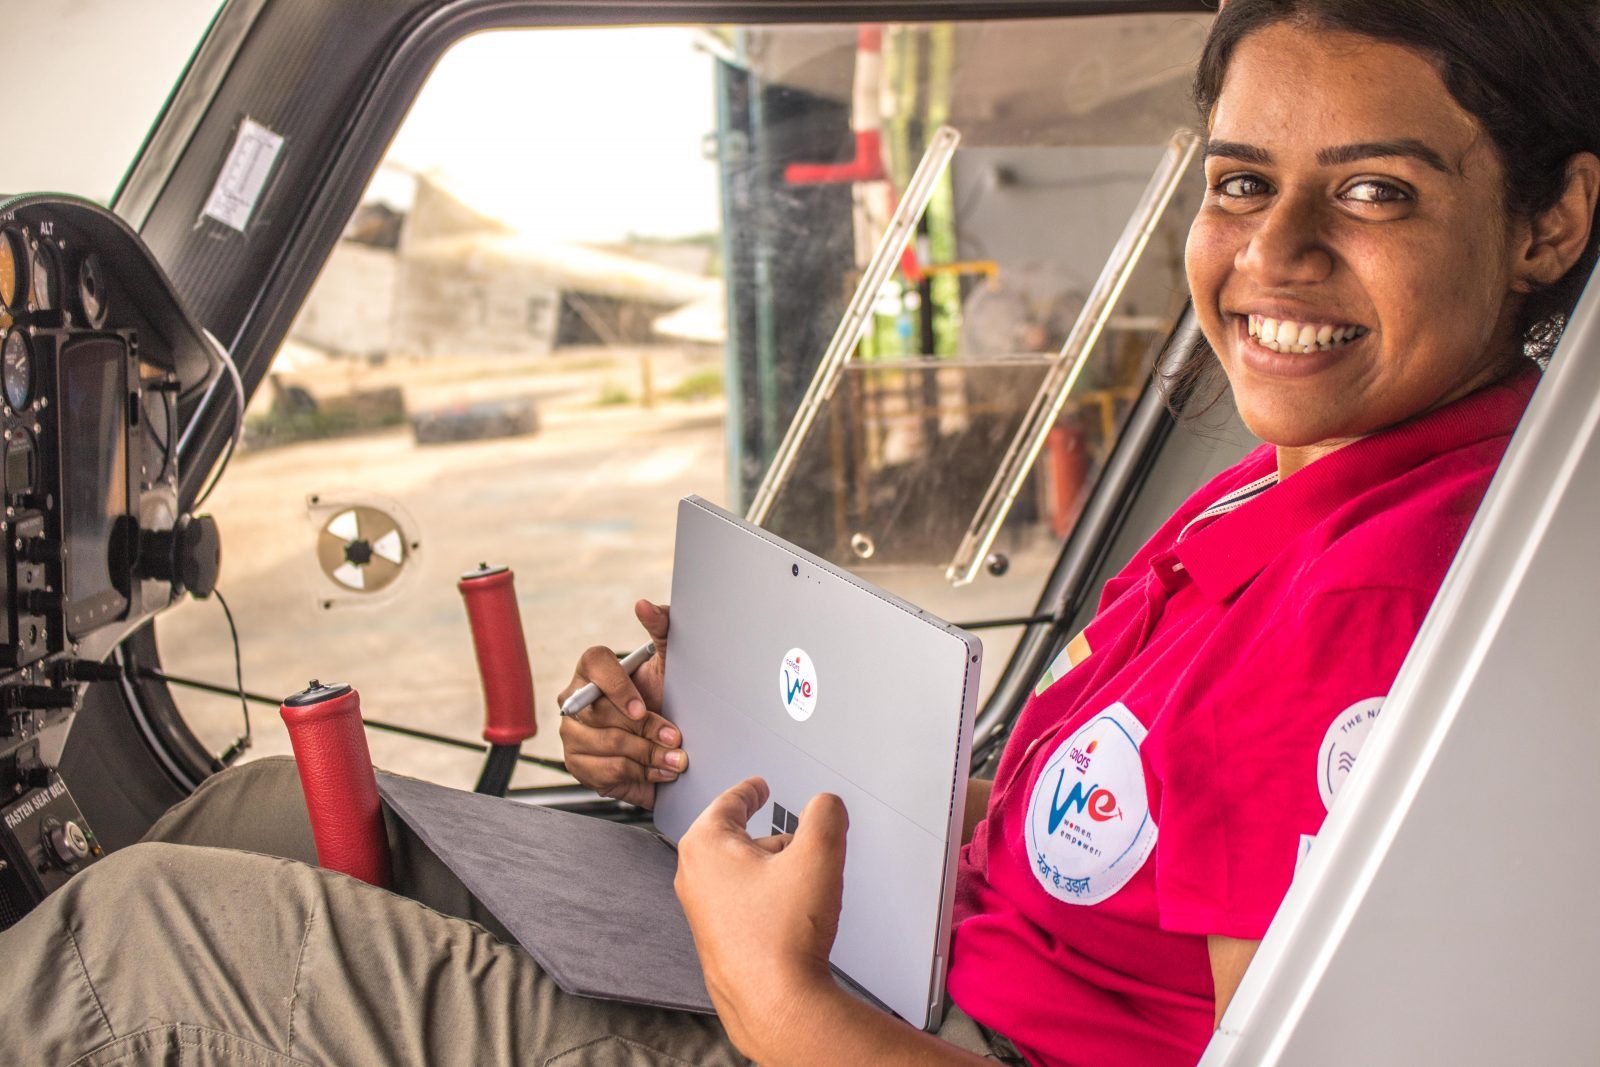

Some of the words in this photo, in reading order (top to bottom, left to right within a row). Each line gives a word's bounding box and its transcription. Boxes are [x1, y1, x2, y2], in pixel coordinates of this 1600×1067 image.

[40, 221, 54, 236] ALT
[784, 669, 811, 705] We
[1340, 713, 1362, 733] THE
[1069, 747, 1091, 769] colors
[4, 801, 35, 829] FASTEN
[32, 788, 51, 810] SEAT
[49, 780, 65, 799] BEL
[1048, 768, 1118, 835] We
[1037, 852, 1052, 879] रंग
